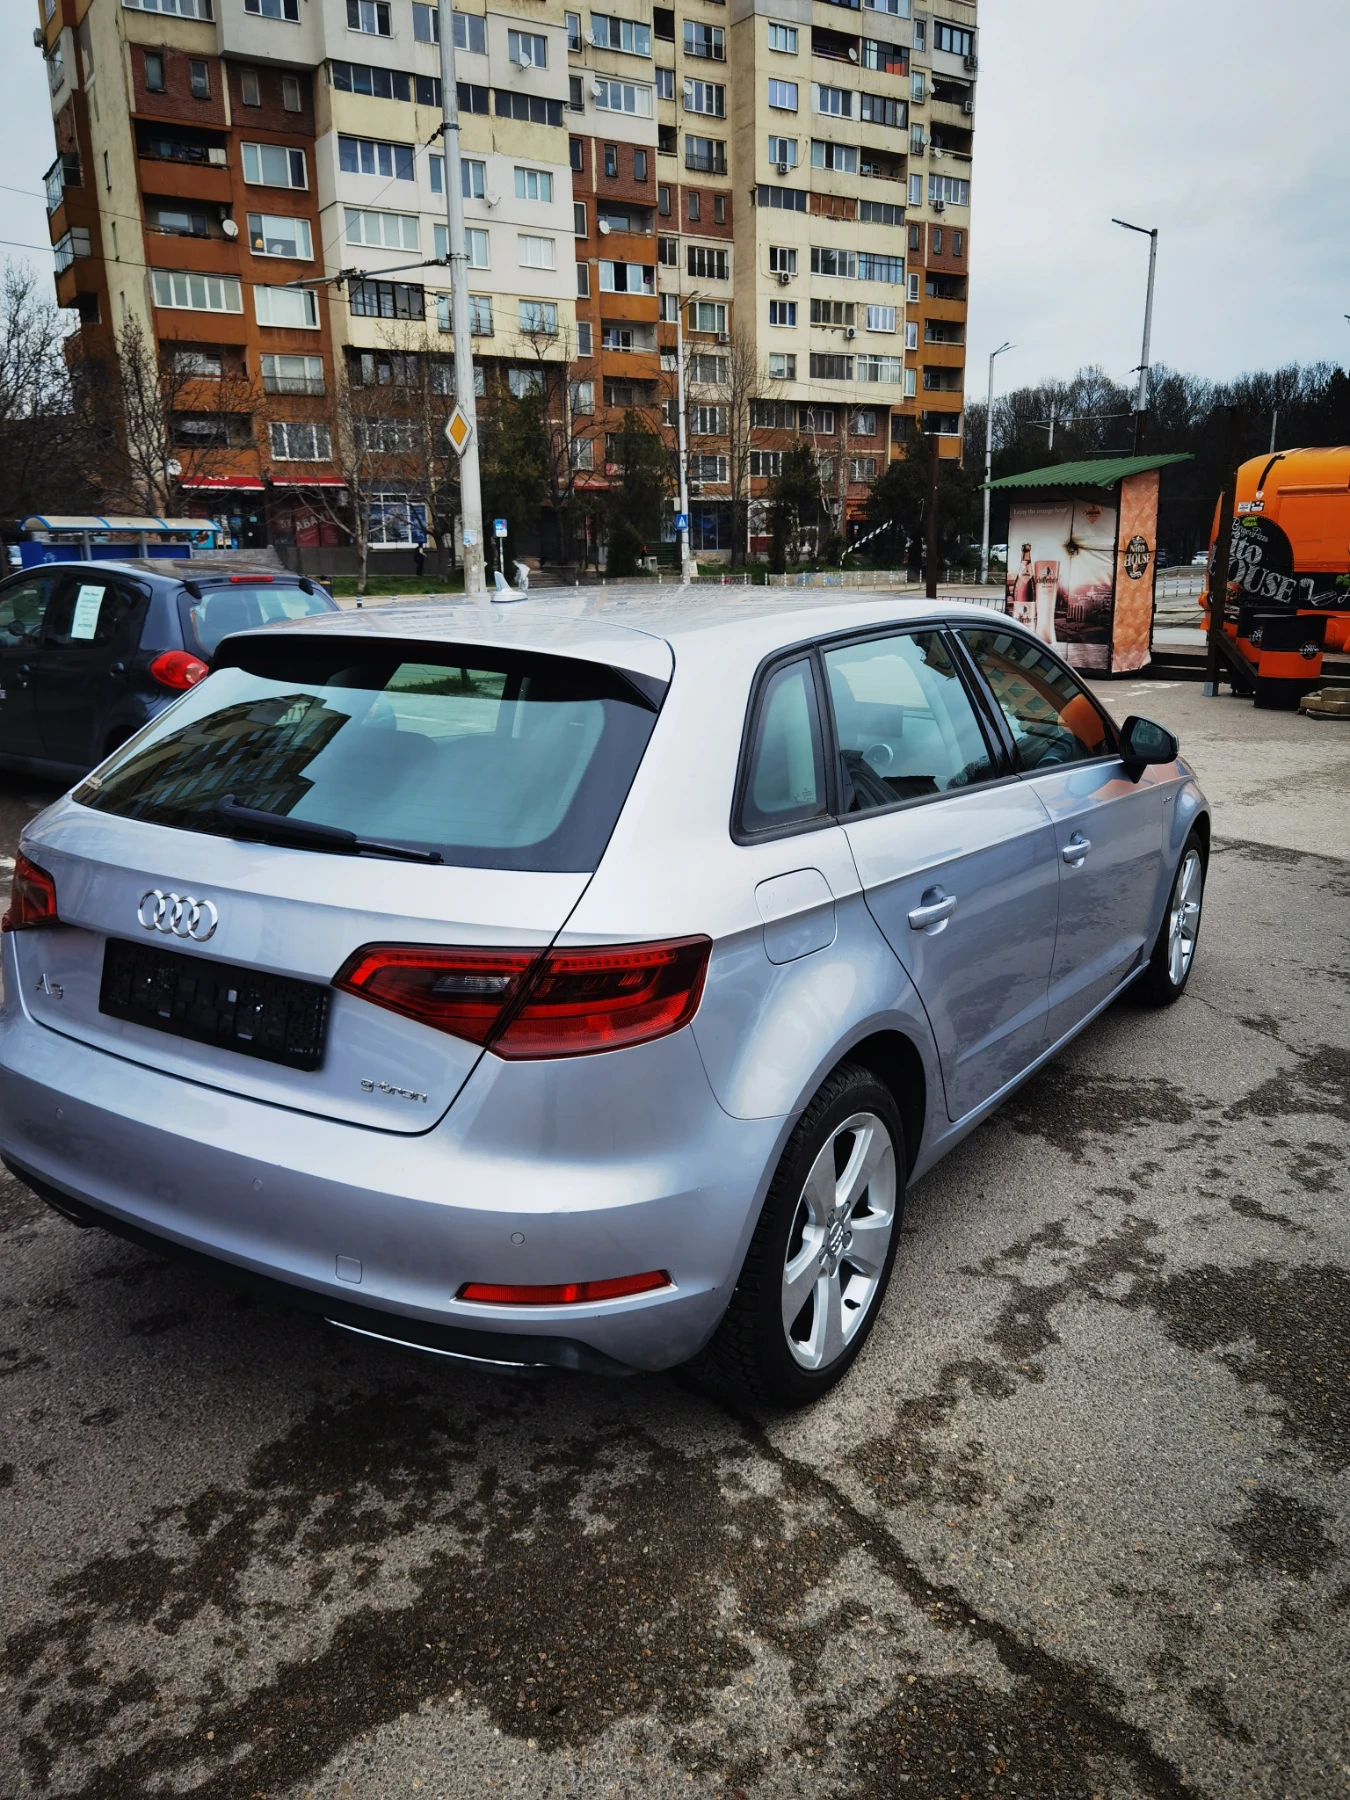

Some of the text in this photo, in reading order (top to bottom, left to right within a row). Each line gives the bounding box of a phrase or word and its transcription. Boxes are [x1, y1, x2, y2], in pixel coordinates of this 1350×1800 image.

[1124, 553, 1151, 567] HOUSE
[1229, 537, 1263, 565] ito
[1227, 558, 1298, 604] OUSE
[360, 1078, 428, 1104] g-tron
